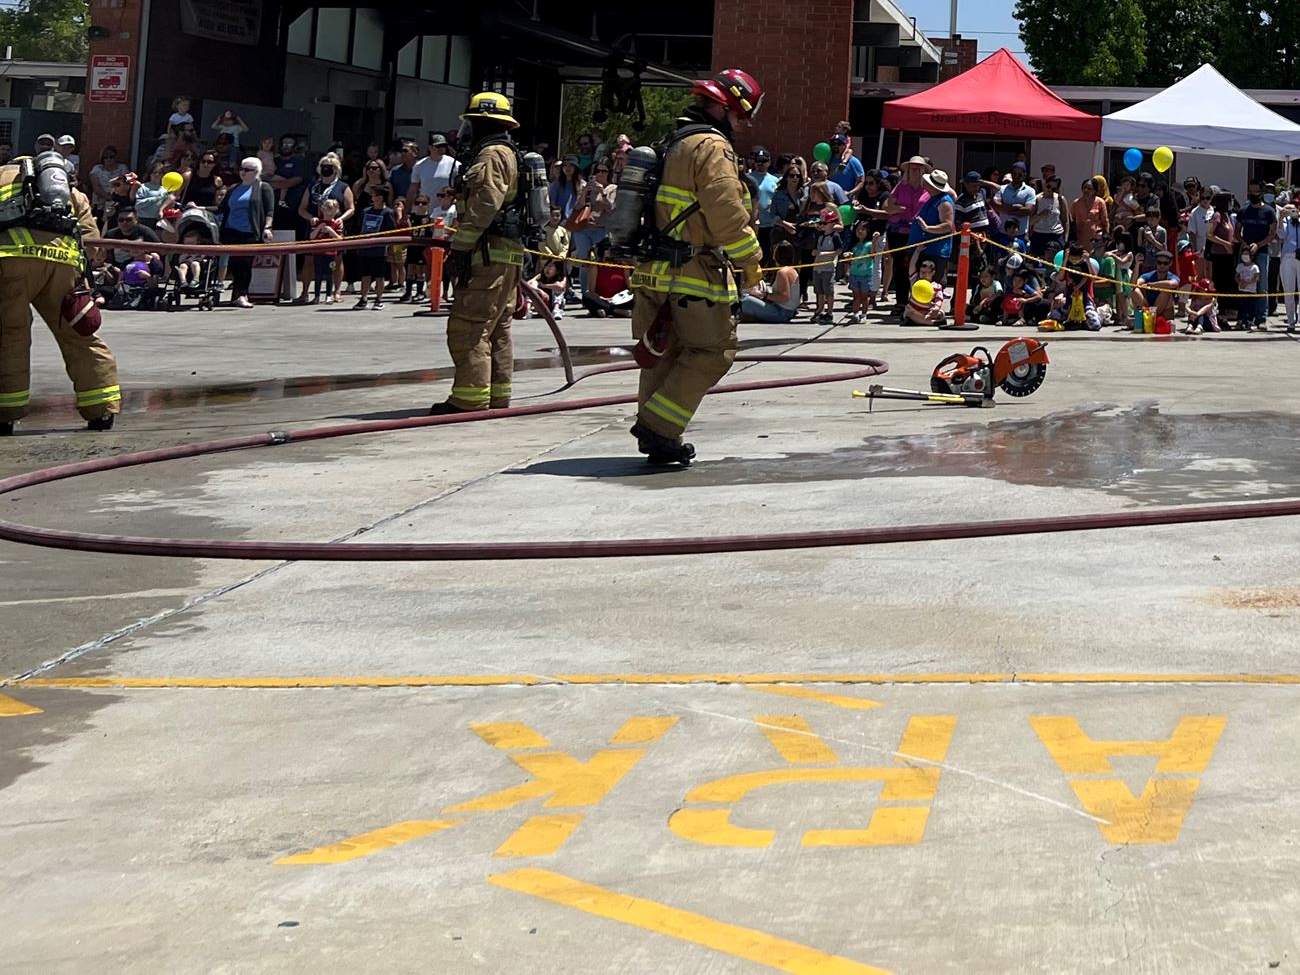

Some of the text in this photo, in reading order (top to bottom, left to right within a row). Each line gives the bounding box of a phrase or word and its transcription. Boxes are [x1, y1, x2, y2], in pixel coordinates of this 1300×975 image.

[988, 113, 1053, 130] Department
[22, 245, 69, 261] REYNOLDS
[252, 254, 282, 267] PEN
